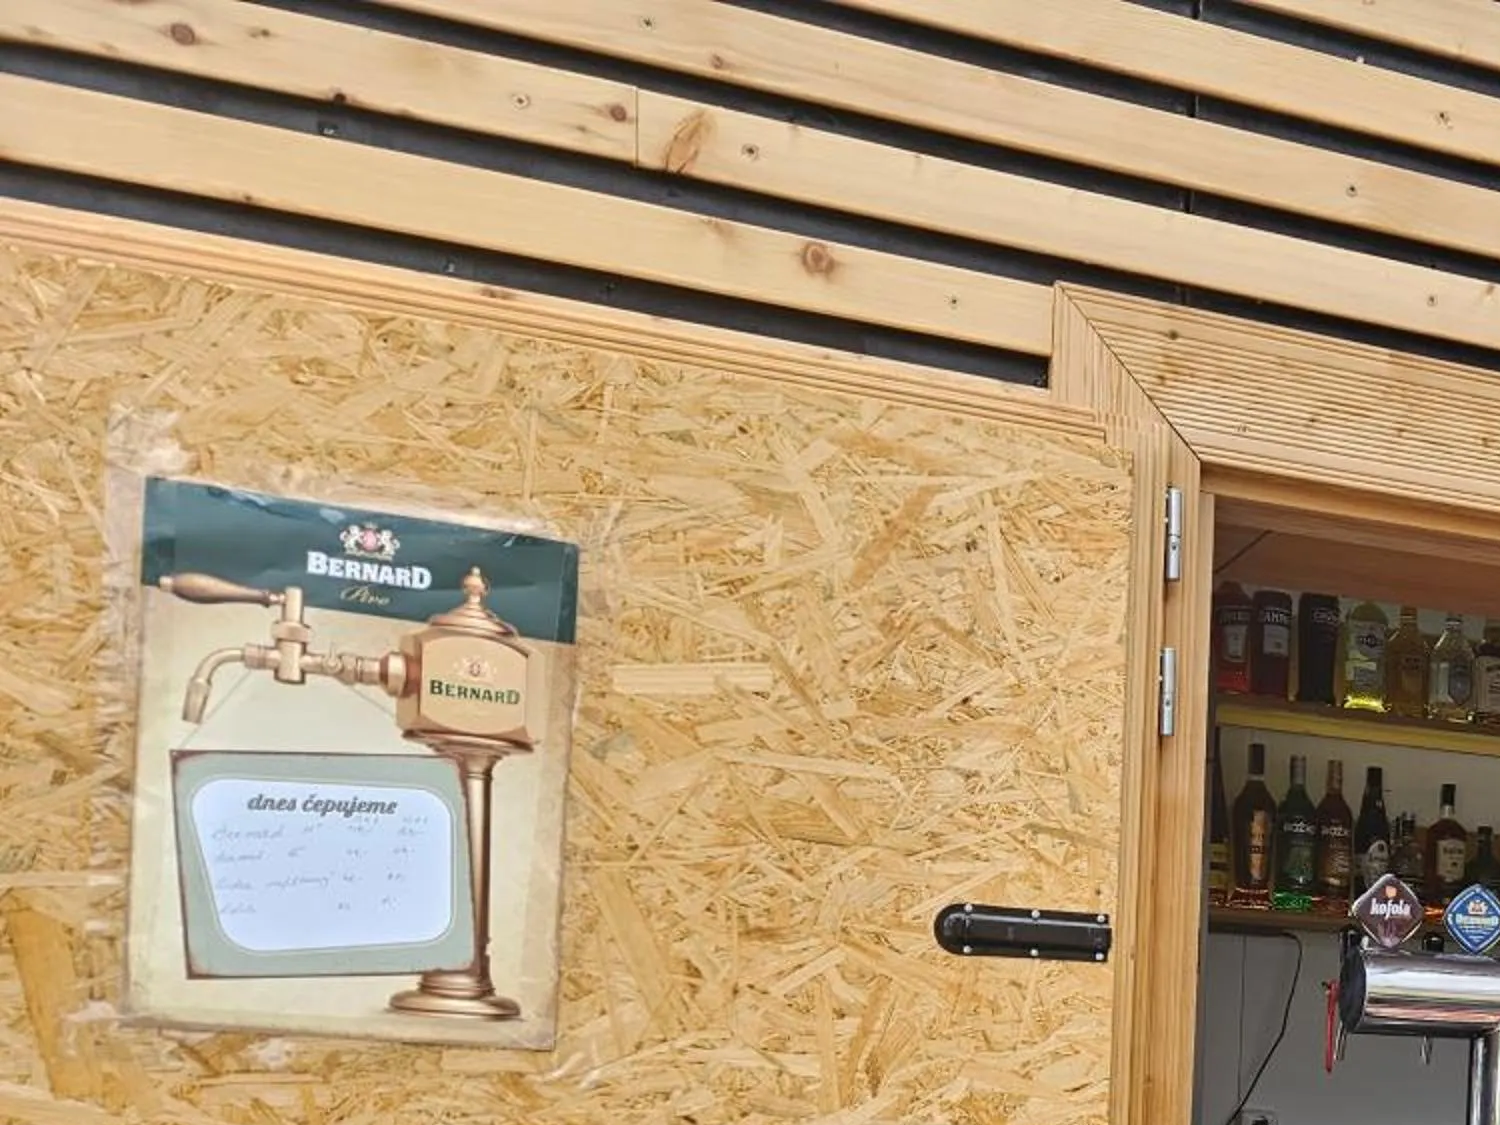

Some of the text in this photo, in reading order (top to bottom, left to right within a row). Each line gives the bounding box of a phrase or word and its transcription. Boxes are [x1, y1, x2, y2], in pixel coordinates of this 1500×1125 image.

[307, 551, 432, 590] BERNARD
[429, 679, 520, 705] BERNARD
[247, 794, 398, 818] dnes čepujeme
[1370, 898, 1411, 920] kofola
